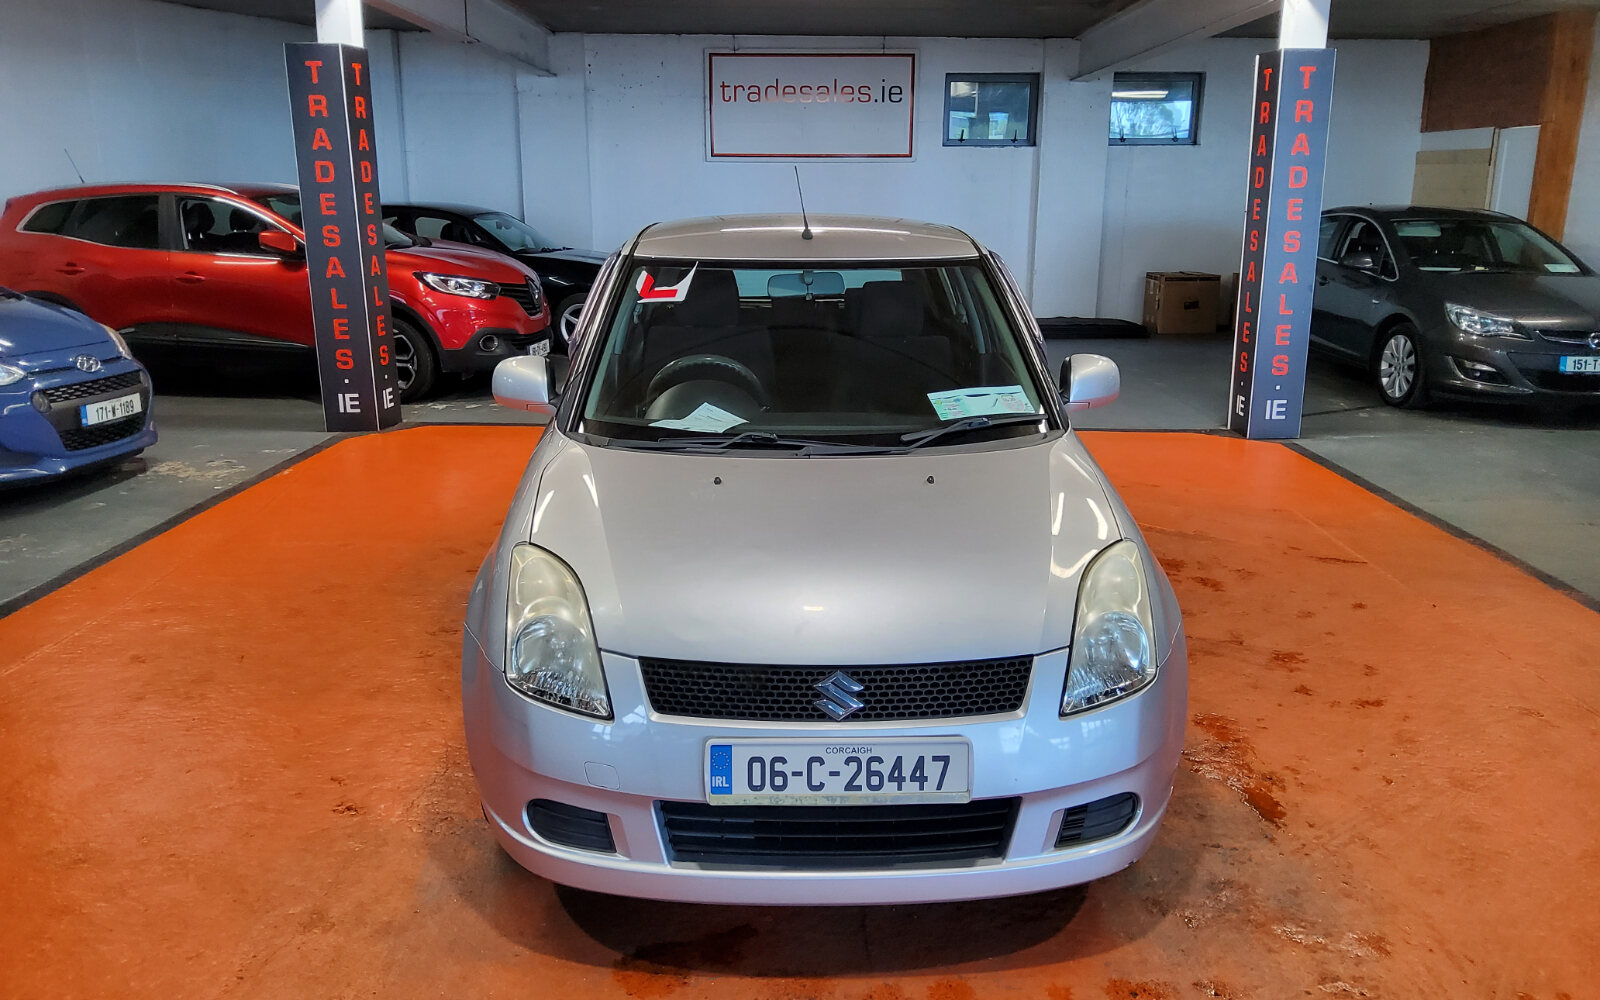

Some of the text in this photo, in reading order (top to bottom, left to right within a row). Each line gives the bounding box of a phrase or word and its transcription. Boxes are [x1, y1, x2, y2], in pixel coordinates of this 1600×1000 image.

[720, 78, 904, 104] tradesales.ie
[1572, 358, 1600, 371] 151-T
[95, 399, 135, 421] 171-W-1189
[825, 746, 873, 755] CORCAIGH
[711, 775, 730, 788] IRL
[746, 754, 951, 793] 06-C-26447
